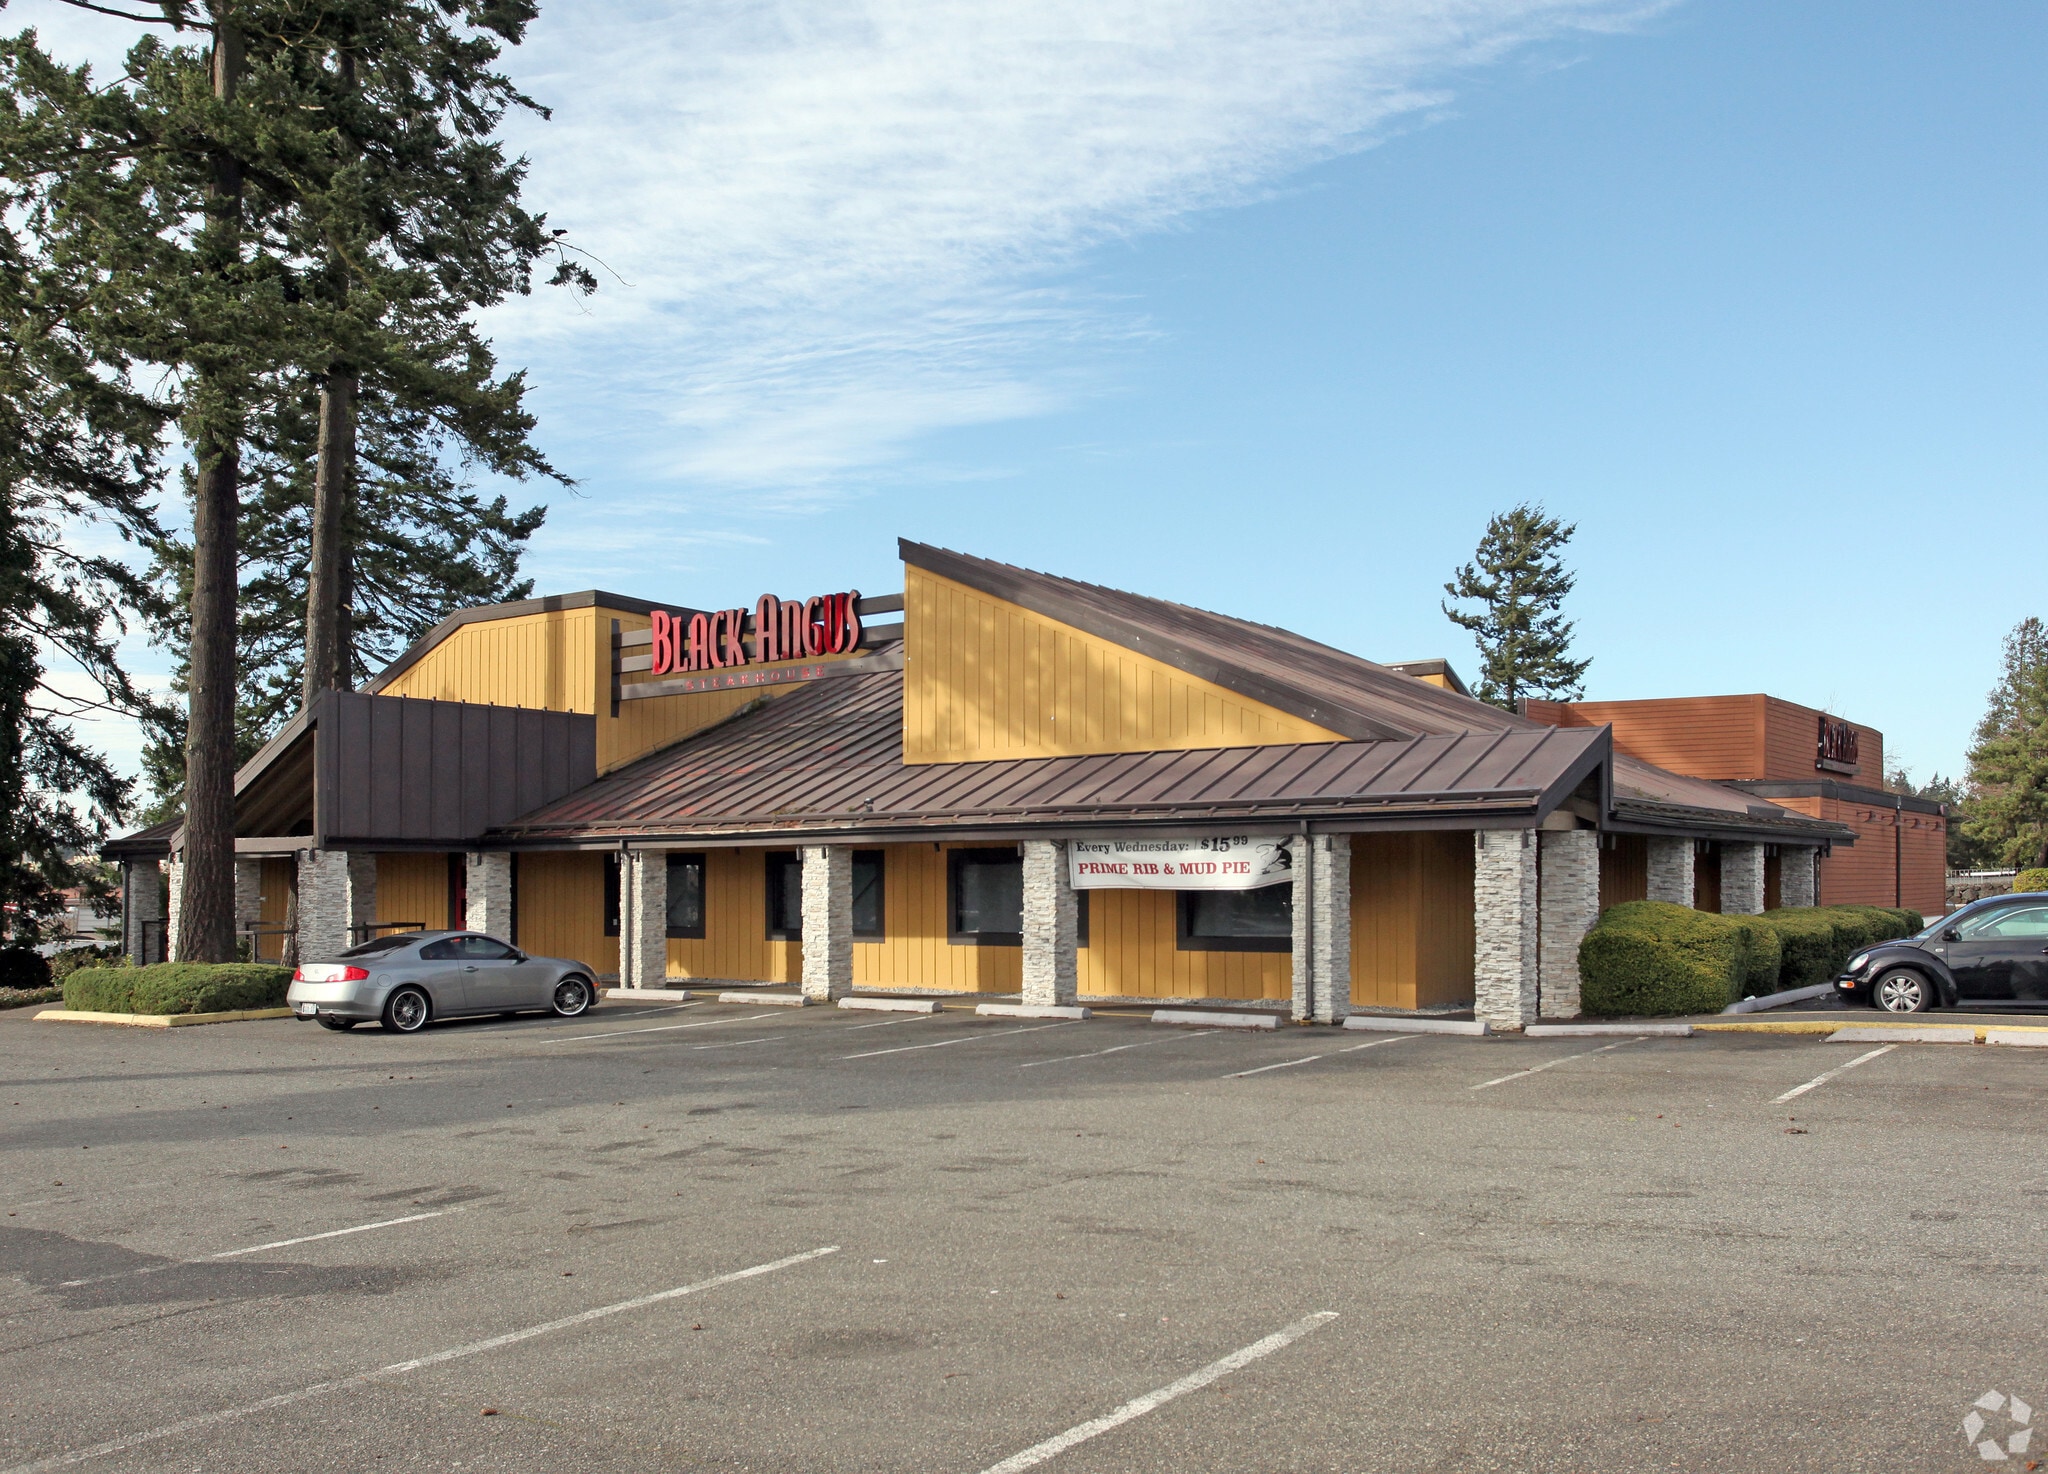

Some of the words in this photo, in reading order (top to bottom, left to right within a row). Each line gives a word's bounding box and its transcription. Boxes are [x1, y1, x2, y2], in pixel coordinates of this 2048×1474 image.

[650, 607, 748, 676] BLACK
[686, 666, 825, 690] STEAKHOUSE
[1076, 842, 1110, 854] Every
[1114, 841, 1189, 852] Wednesday:
[1078, 862, 1128, 875] PRIME
[1133, 862, 1159, 875] RIB
[1163, 862, 1175, 875] &
[1180, 862, 1218, 875] MUD
[1222, 861, 1251, 874] PIE
